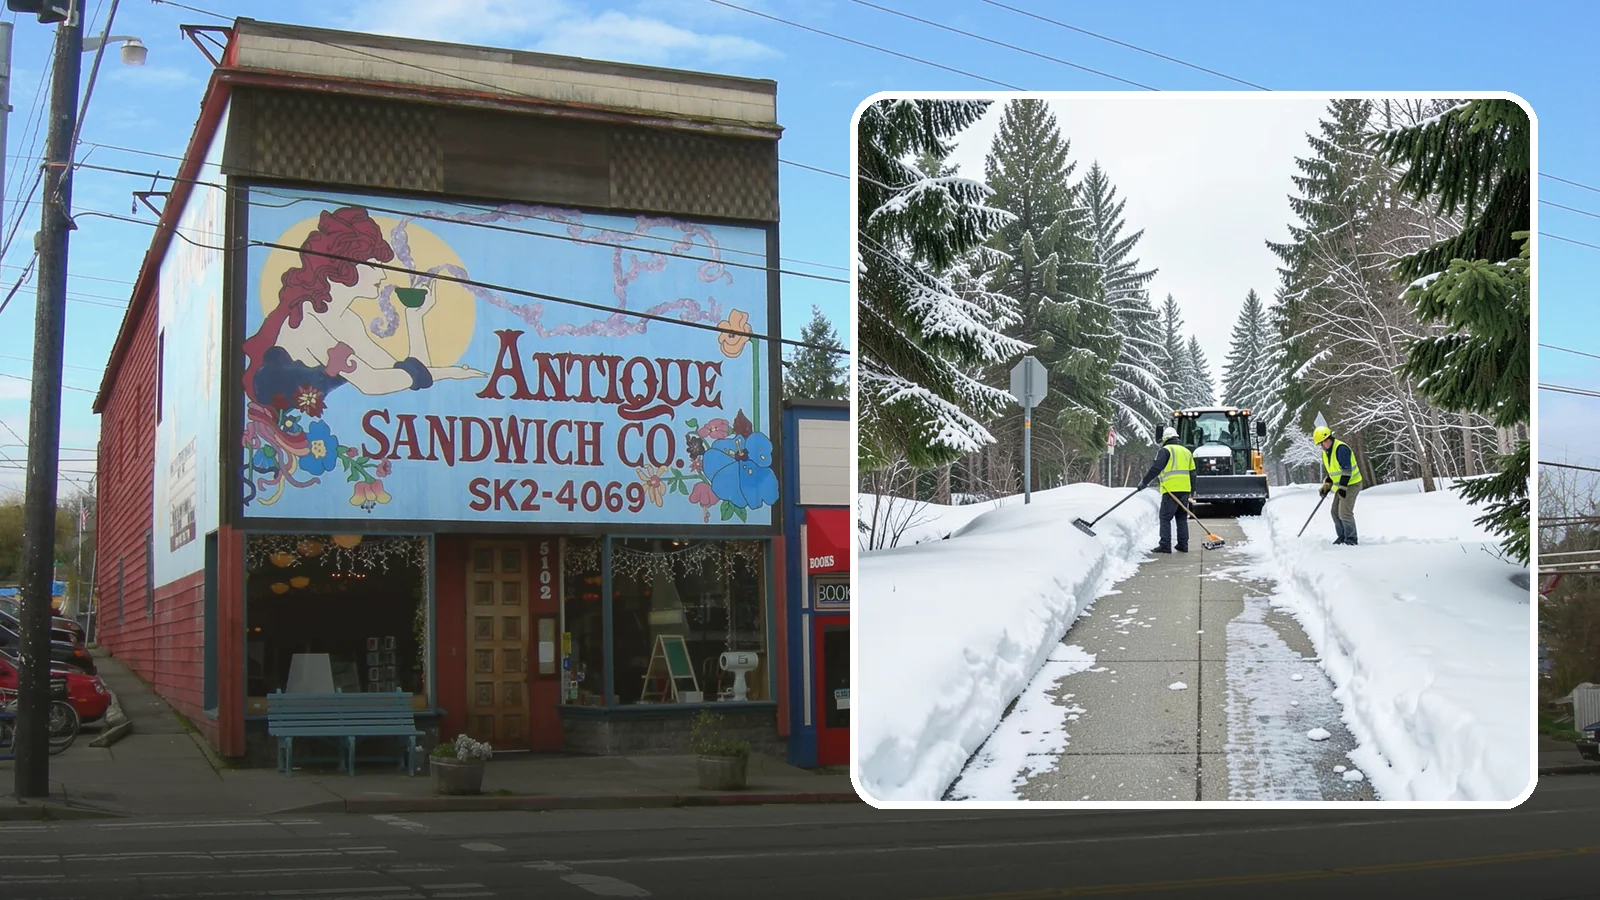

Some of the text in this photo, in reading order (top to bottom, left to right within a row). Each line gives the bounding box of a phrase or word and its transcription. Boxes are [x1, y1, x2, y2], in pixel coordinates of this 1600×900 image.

[476, 329, 724, 420] ANTIQUE
[361, 408, 684, 468] SANDWICH CO.
[469, 478, 646, 512] SK2-4069
[540, 541, 551, 599] 5102
[809, 555, 835, 569] BOOKS
